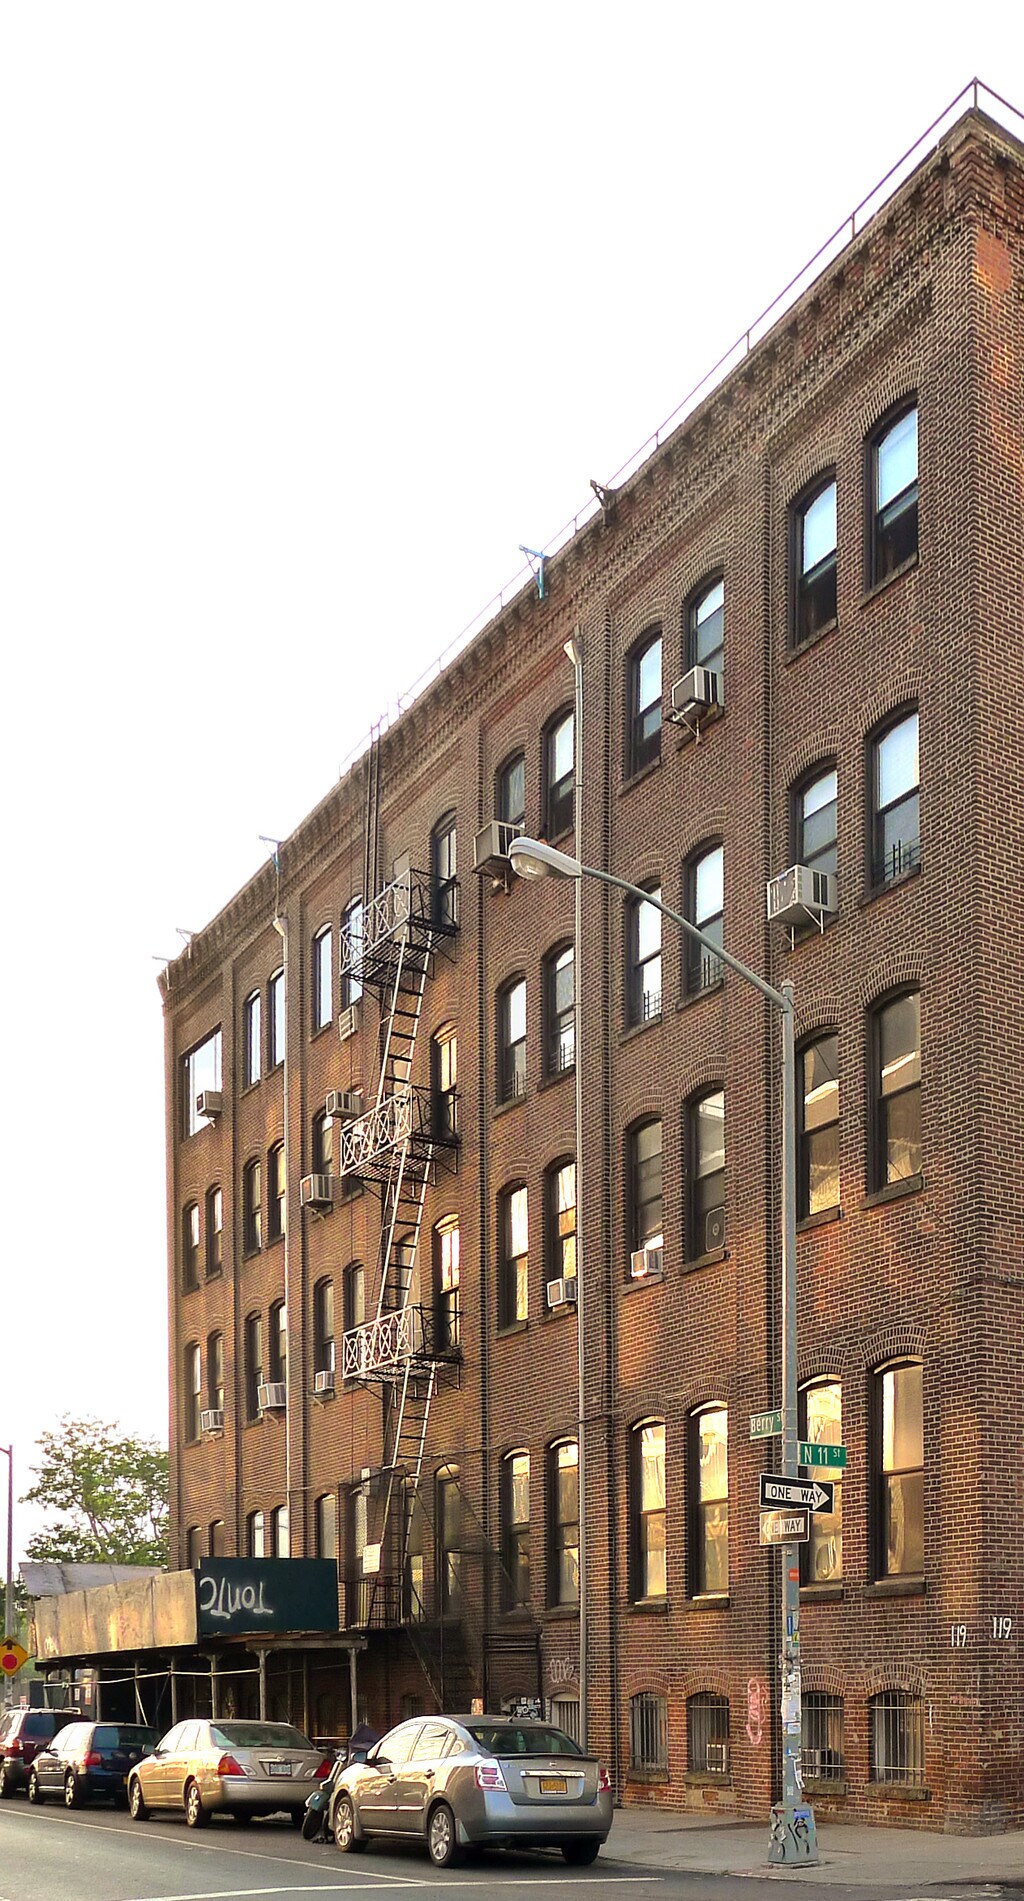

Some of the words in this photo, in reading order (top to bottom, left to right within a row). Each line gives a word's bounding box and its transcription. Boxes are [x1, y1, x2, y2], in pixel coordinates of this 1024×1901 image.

[750, 1416, 774, 1433] Berry
[804, 1446, 812, 1463] N
[818, 1447, 828, 1464] 11
[771, 1486, 792, 1499] ONE
[801, 1489, 822, 1502] WAY
[784, 1519, 801, 1533] WAY
[951, 1624, 967, 1647] 119
[991, 1616, 1012, 1639] 119
